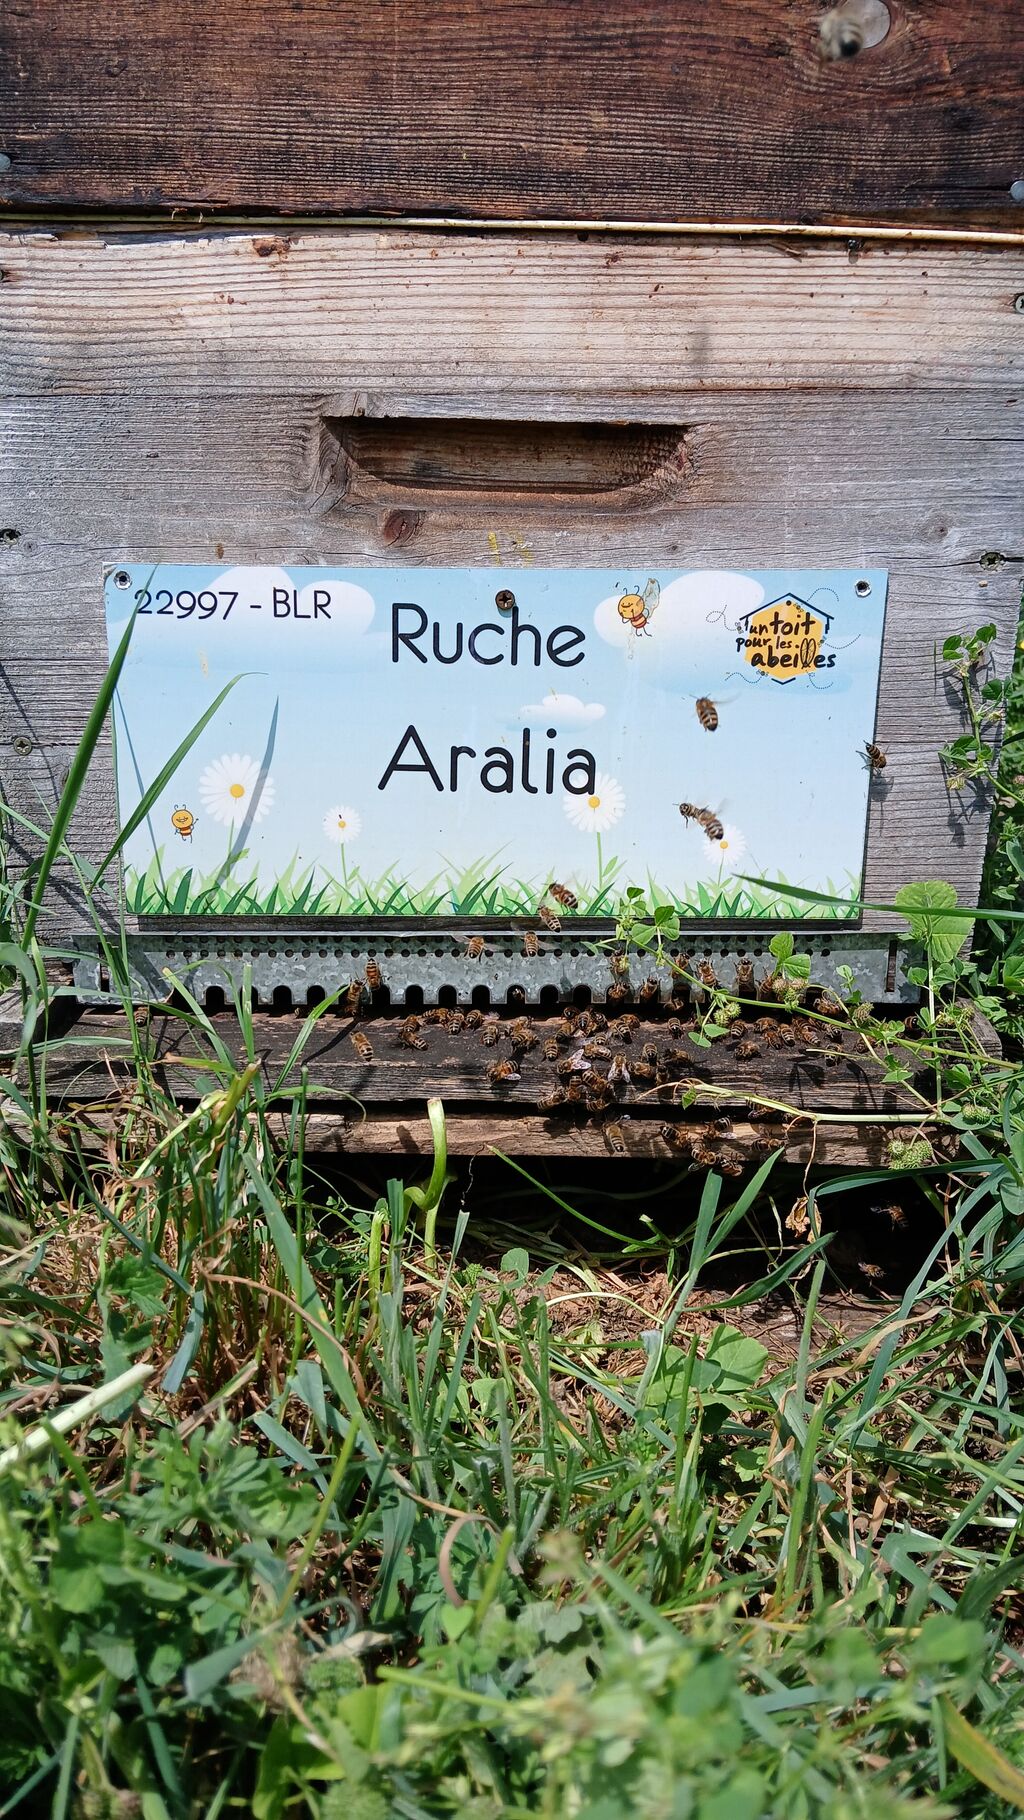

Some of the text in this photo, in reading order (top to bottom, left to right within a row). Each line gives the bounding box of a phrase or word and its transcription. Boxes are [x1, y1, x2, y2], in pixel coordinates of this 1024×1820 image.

[134, 589, 239, 620] 22997
[273, 588, 332, 619] BLR
[392, 602, 586, 667] Ruche
[749, 611, 816, 636] un toit
[736, 636, 792, 653] pour les
[751, 638, 836, 668] abeilles
[377, 724, 596, 795] Aralia
